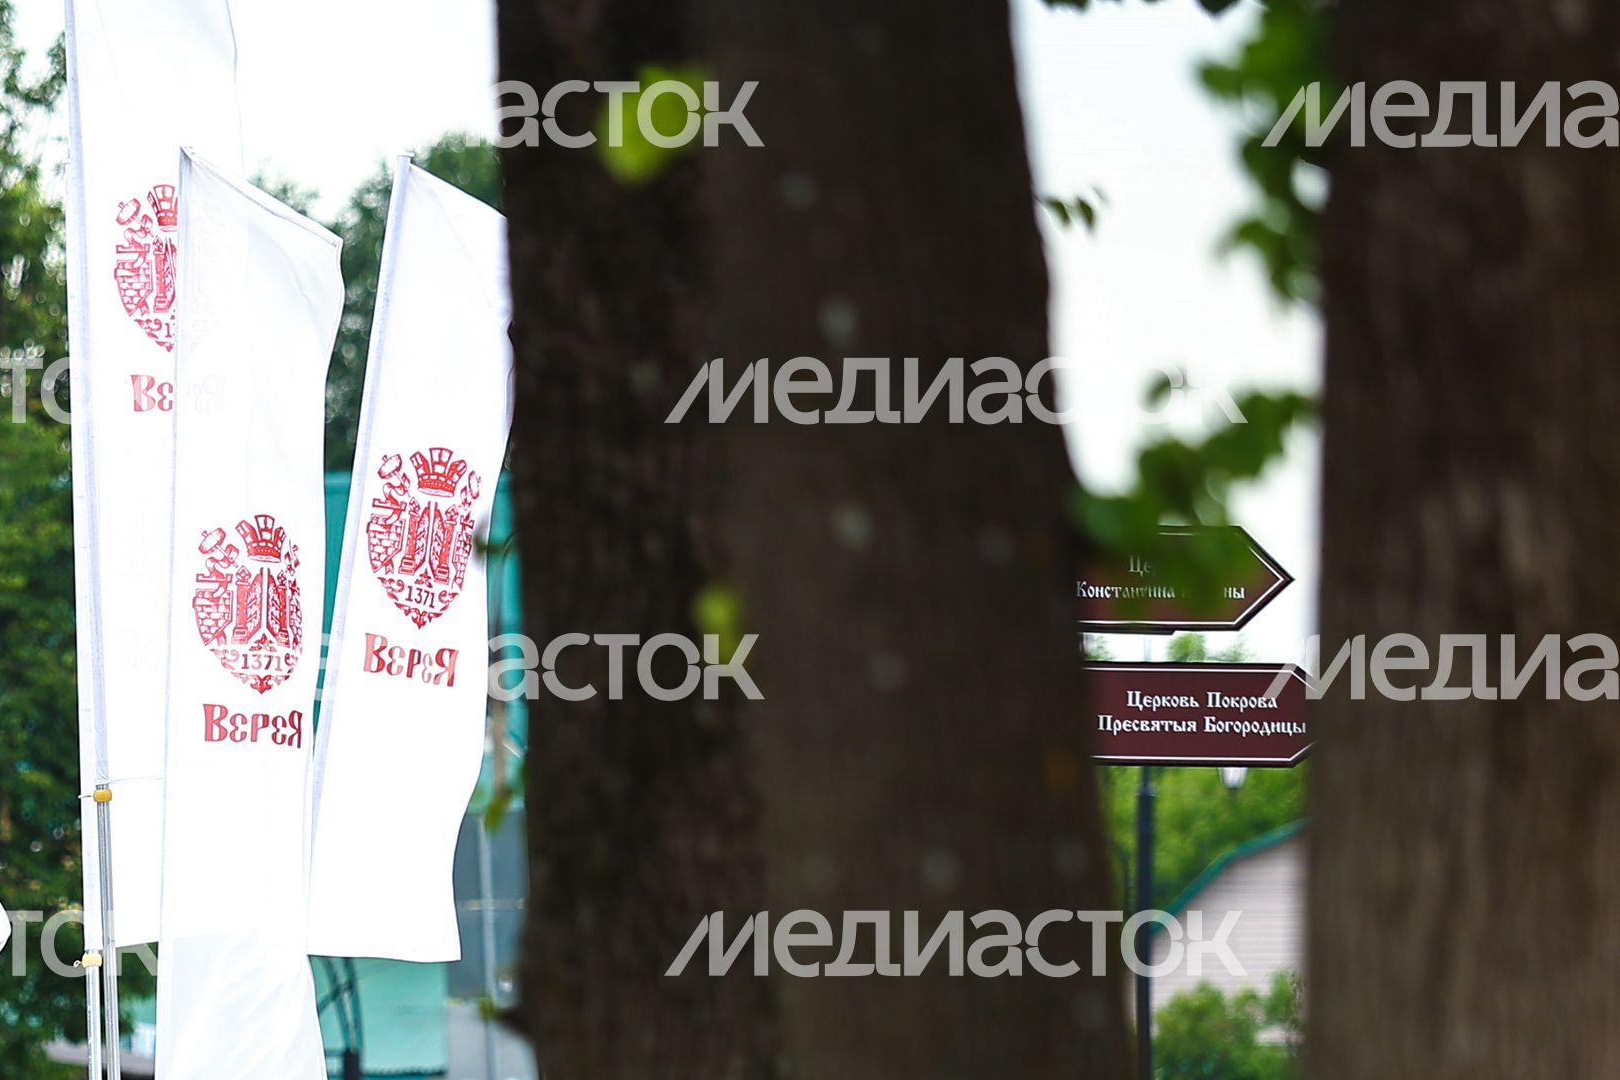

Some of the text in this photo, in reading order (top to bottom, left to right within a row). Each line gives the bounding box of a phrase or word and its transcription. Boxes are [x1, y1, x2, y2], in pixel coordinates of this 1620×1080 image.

[405, 585, 435, 609] 1371
[241, 653, 283, 672] 1371
[1126, 690, 1278, 713] Церковь Покрова
[1097, 714, 1307, 737] Пресвятыя Богородицы
